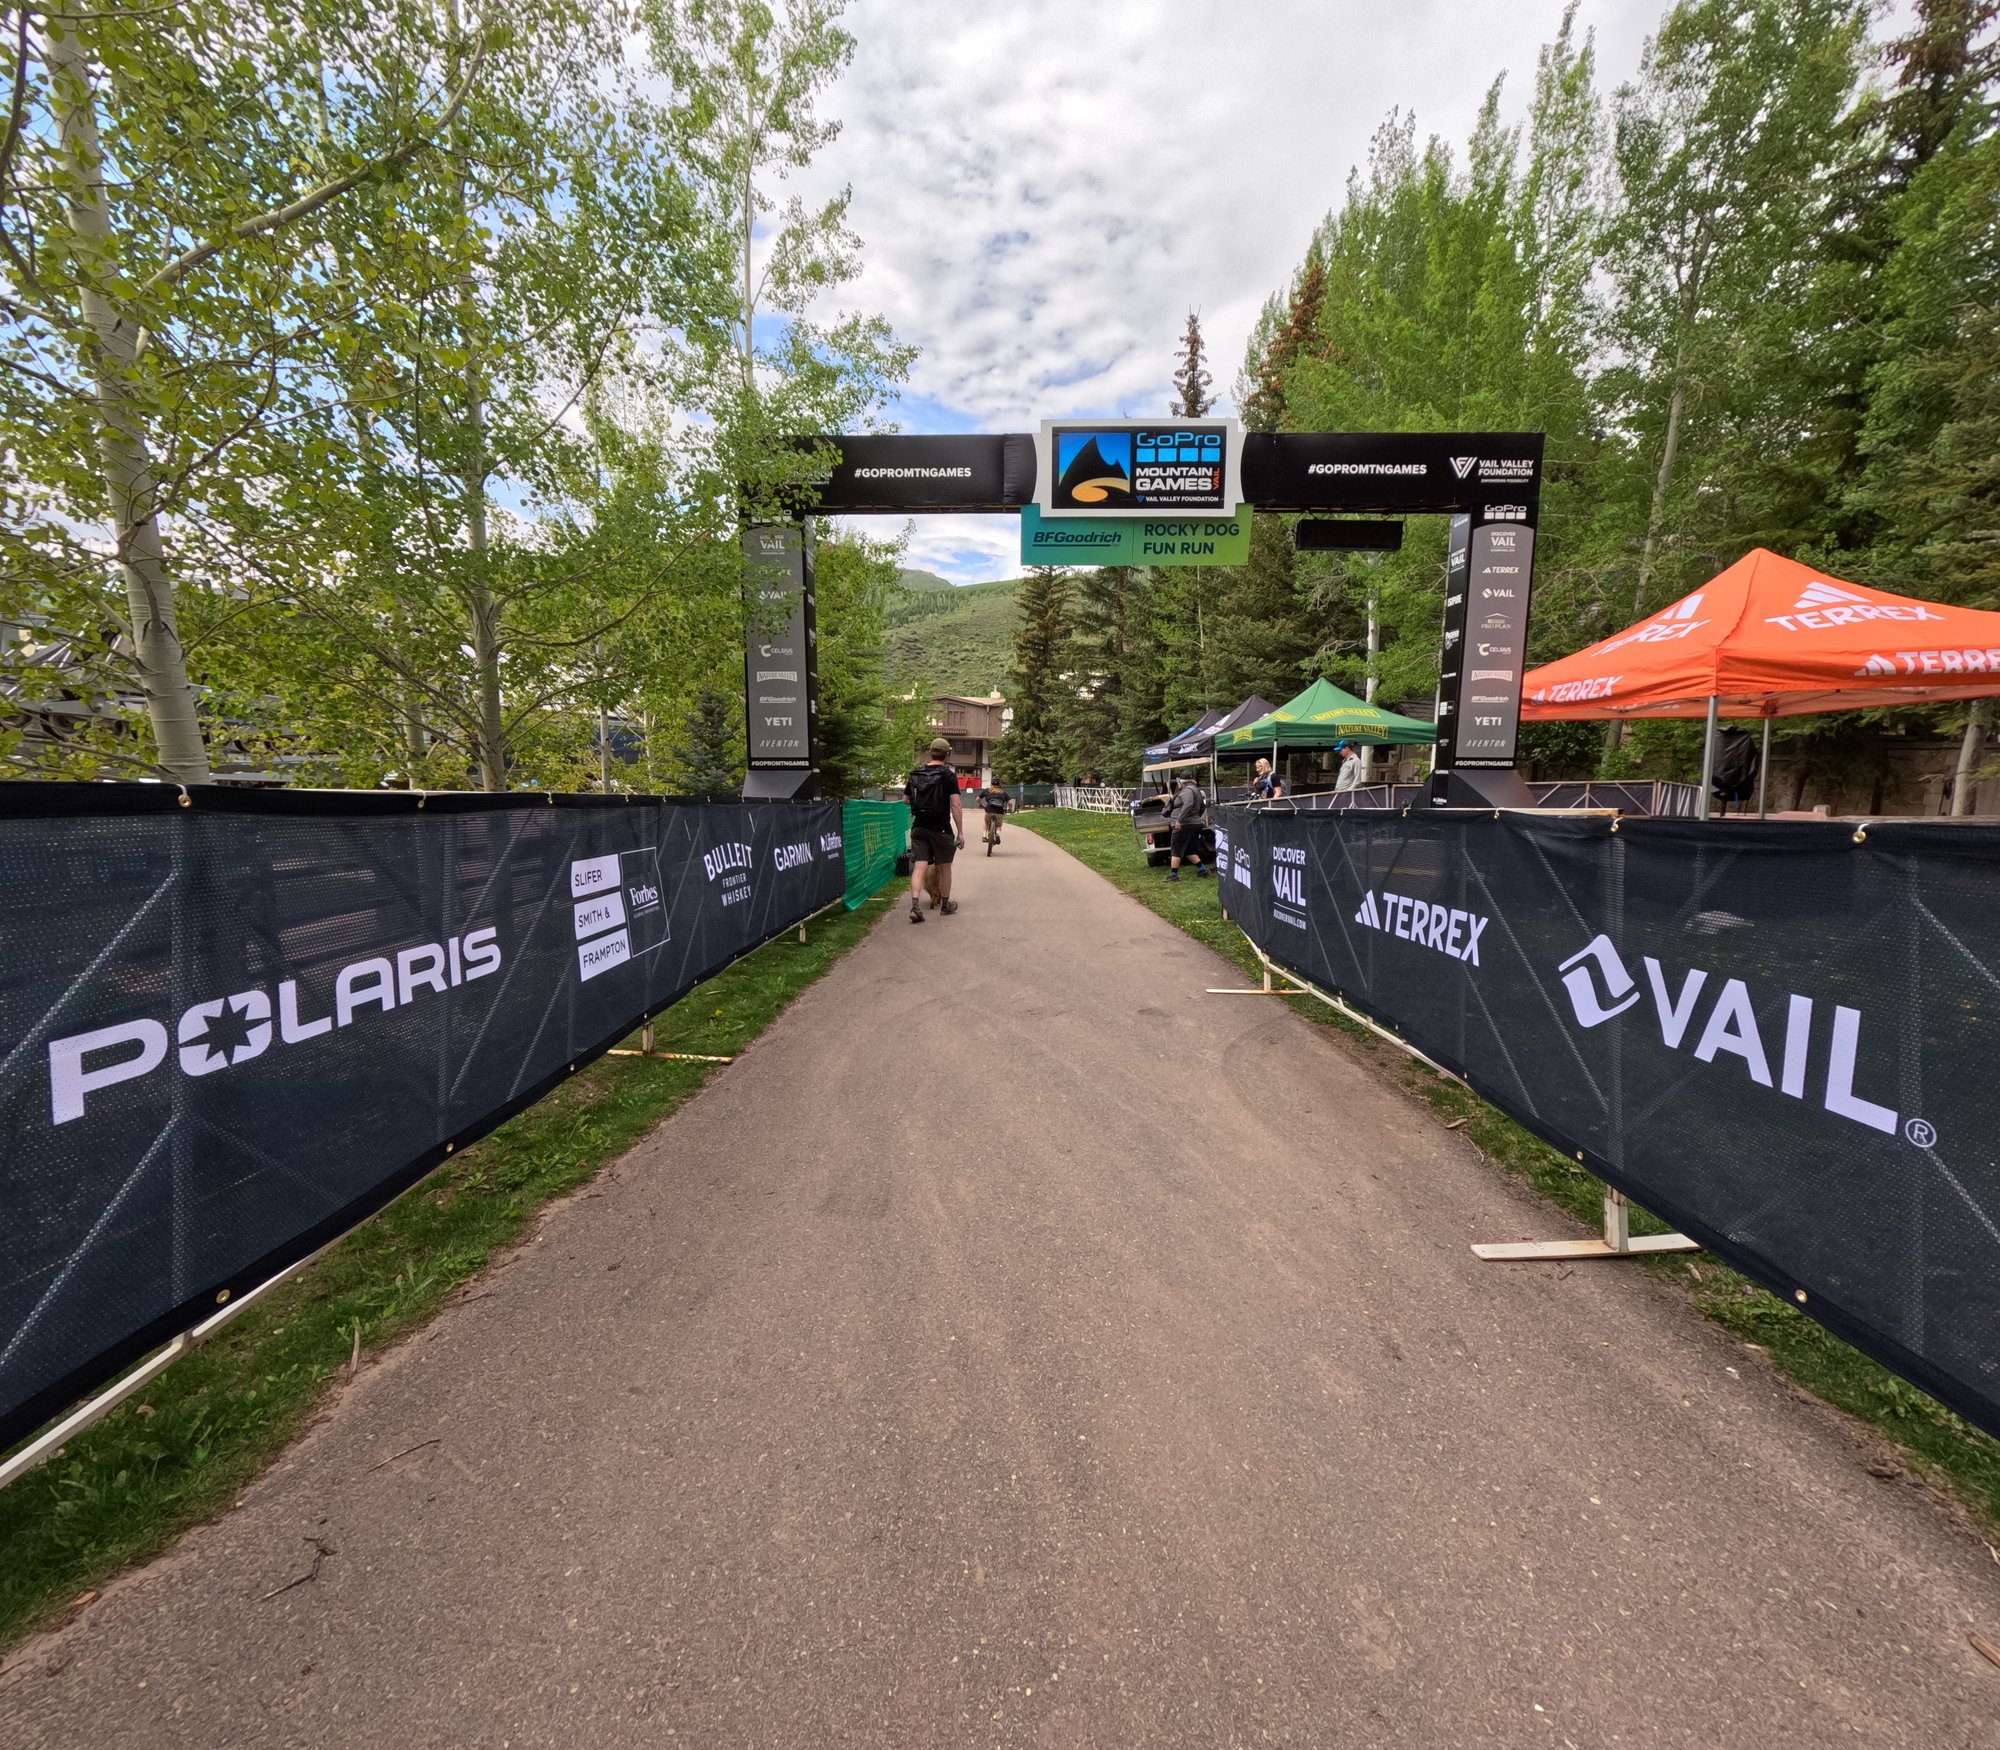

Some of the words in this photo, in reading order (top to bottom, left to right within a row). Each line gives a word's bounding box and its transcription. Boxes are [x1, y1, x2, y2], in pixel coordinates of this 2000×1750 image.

[1136, 432, 1221, 446] GoPro
[1308, 464, 1427, 475] #GOPROMTNGAMES
[1479, 459, 1499, 468] VAIL
[1500, 459, 1534, 468] VALLEY
[854, 467, 972, 478] #GOPROMTNGAMES
[1135, 467, 1212, 477] MOUNTAIN
[1478, 468, 1534, 476] FOUNDATION
[1135, 477, 1212, 491] GAMES
[1485, 504, 1527, 512] GoPro
[1144, 523, 1200, 536] ROCKY
[1204, 523, 1240, 536] DOG
[1033, 531, 1122, 543] BFGoodrich
[1491, 537, 1516, 546] VAIL
[760, 540, 785, 549] VAIL
[1143, 541, 1175, 555] FUN
[1180, 541, 1214, 555] RUN
[1491, 566, 1520, 574] TERREX
[1493, 589, 1514, 598] VAIL
[1764, 604, 1946, 631] TERREX
[1548, 675, 1624, 703] TERREX
[764, 716, 793, 726] YETI
[1474, 716, 1502, 726] YETI
[1338, 725, 1364, 736] NATURE
[1364, 725, 1386, 737] VALLEY
[760, 740, 800, 748] AVENTON
[703, 842, 752, 882] BULLEIT
[774, 842, 812, 871] GARMIN
[1234, 845, 1251, 868] GoPro
[1273, 846, 1306, 866] DISCOVER
[575, 869, 602, 887] SLIFER
[722, 873, 747, 888] FRONTIER
[1272, 865, 1306, 907] VAIL
[629, 884, 659, 906] Forbes
[721, 885, 751, 907] WHISKEY
[578, 909, 603, 928] SMITH
[604, 906, 611, 919] &
[1383, 892, 1489, 967] TERREX
[583, 939, 626, 969] FRAMPTON
[48, 926, 501, 1126] POLARIS
[1643, 956, 1899, 1136] VAIL
